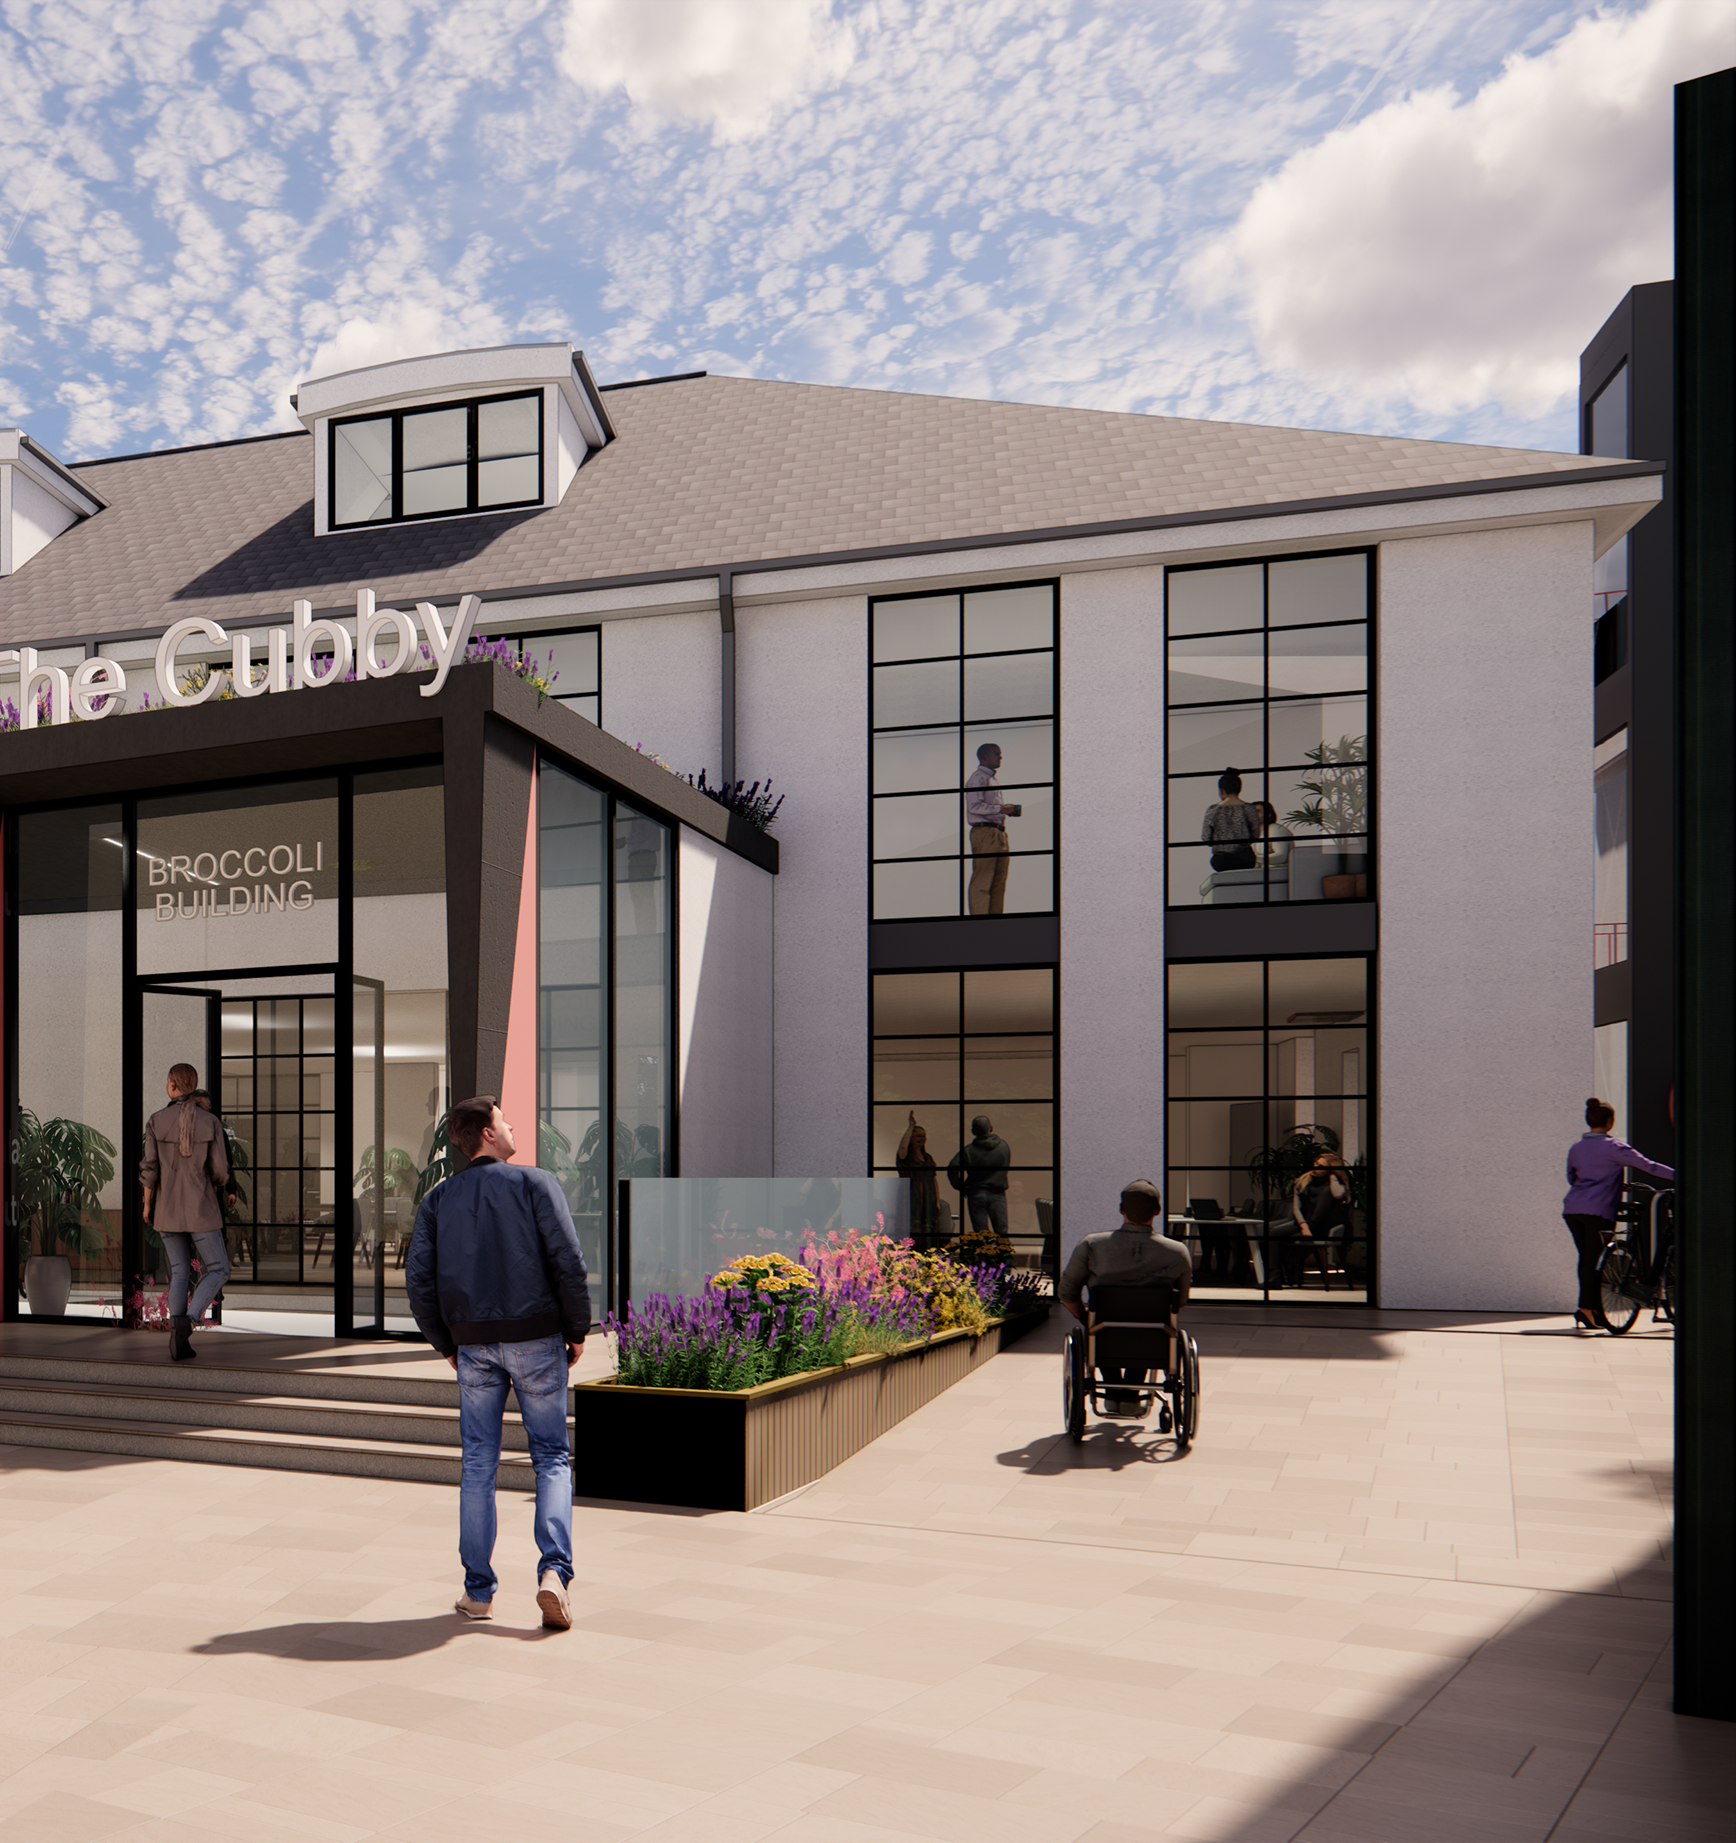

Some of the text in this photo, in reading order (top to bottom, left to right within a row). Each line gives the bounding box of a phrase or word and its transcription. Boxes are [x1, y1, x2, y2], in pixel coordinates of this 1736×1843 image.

[154, 587, 482, 707] Cubby
[149, 841, 324, 886] BROCCOLI
[156, 880, 315, 922] BUILDING
